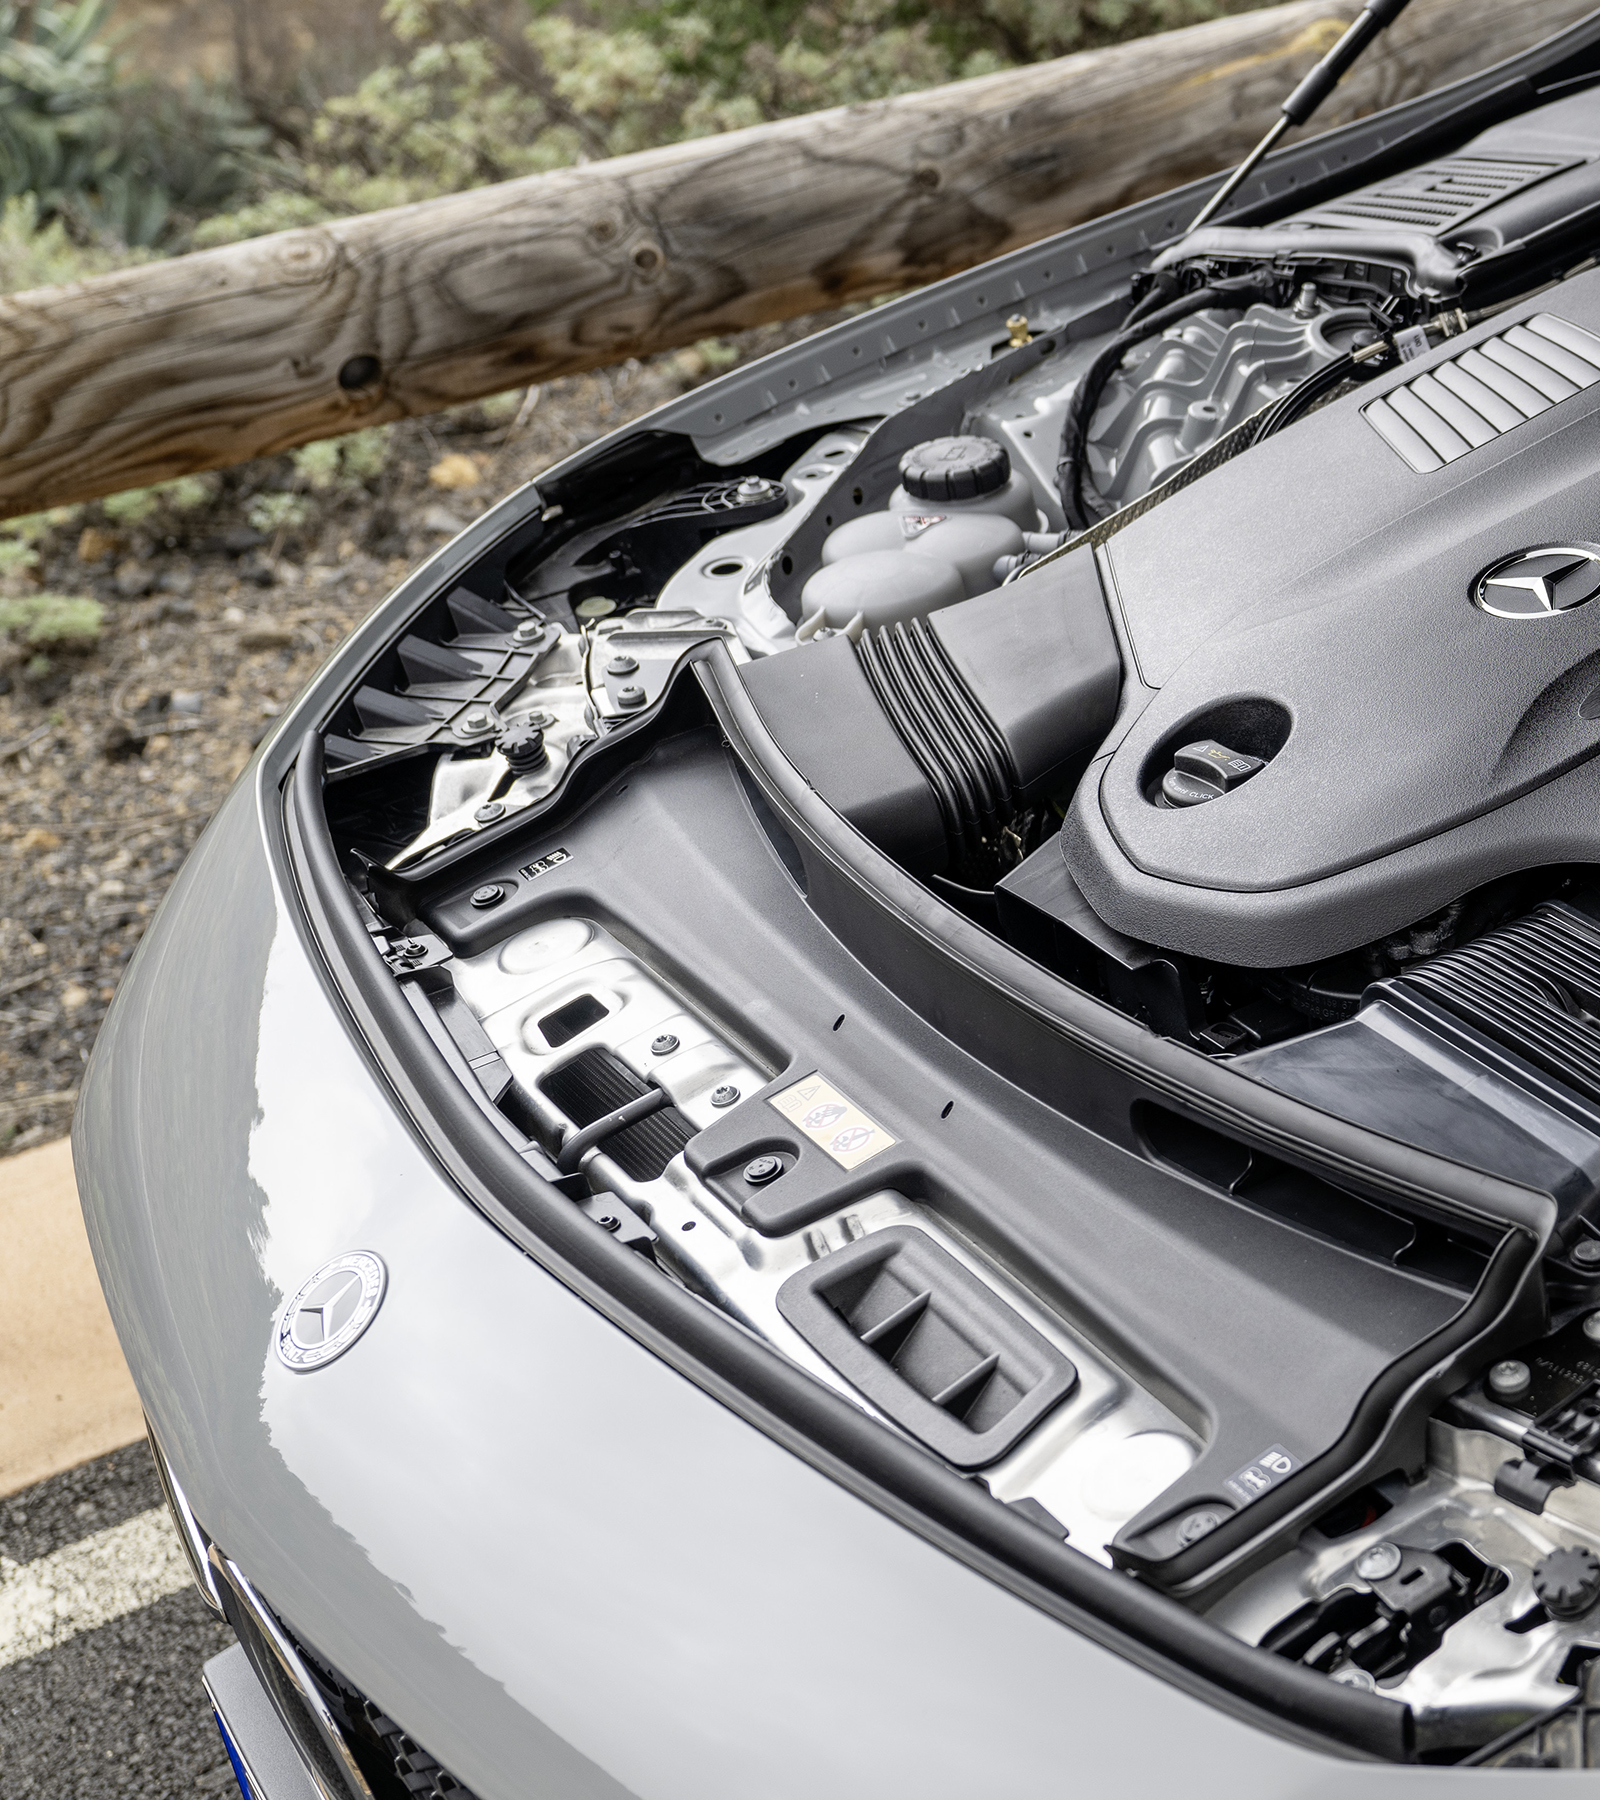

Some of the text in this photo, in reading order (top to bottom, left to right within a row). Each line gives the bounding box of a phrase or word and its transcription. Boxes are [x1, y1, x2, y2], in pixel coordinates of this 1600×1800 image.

[1189, 787, 1215, 800] CLICK
[340, 1255, 380, 1298] MERCEDES
[280, 1336, 303, 1362] BENZ
